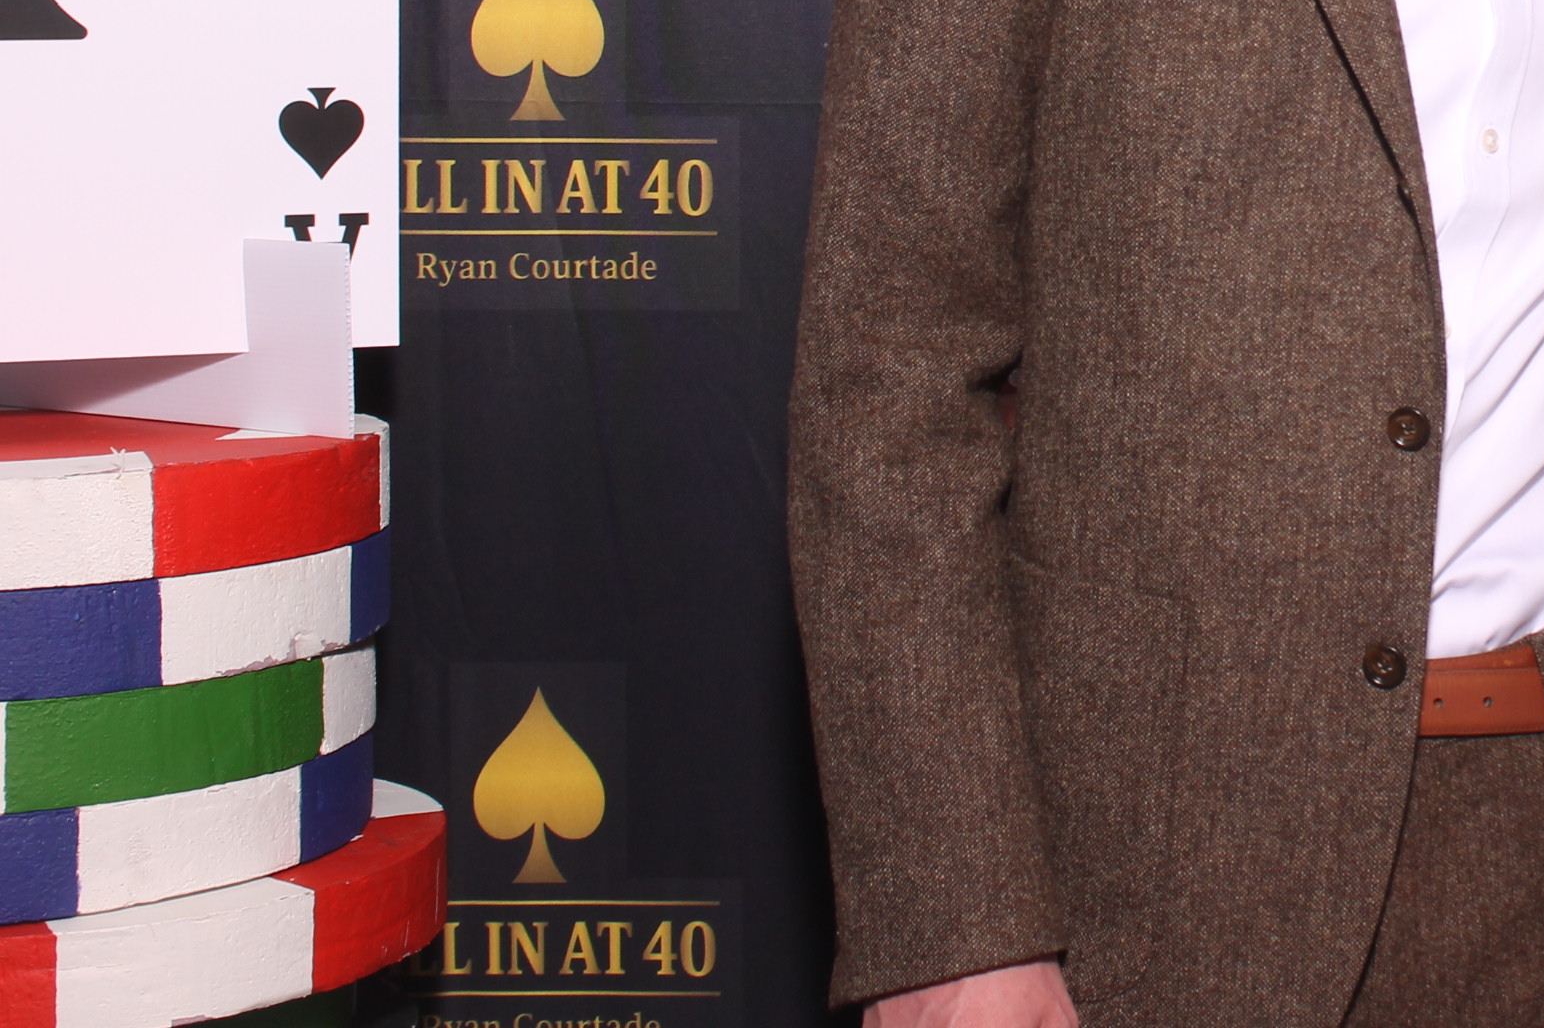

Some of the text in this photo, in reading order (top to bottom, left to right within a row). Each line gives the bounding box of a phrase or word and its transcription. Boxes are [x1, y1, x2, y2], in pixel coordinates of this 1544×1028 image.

[400, 158, 715, 217] LL IN AT 40
[415, 251, 658, 287] Ryan Courtade
[484, 921, 549, 976] IN
[558, 921, 634, 976] AT
[641, 920, 718, 978] 40
